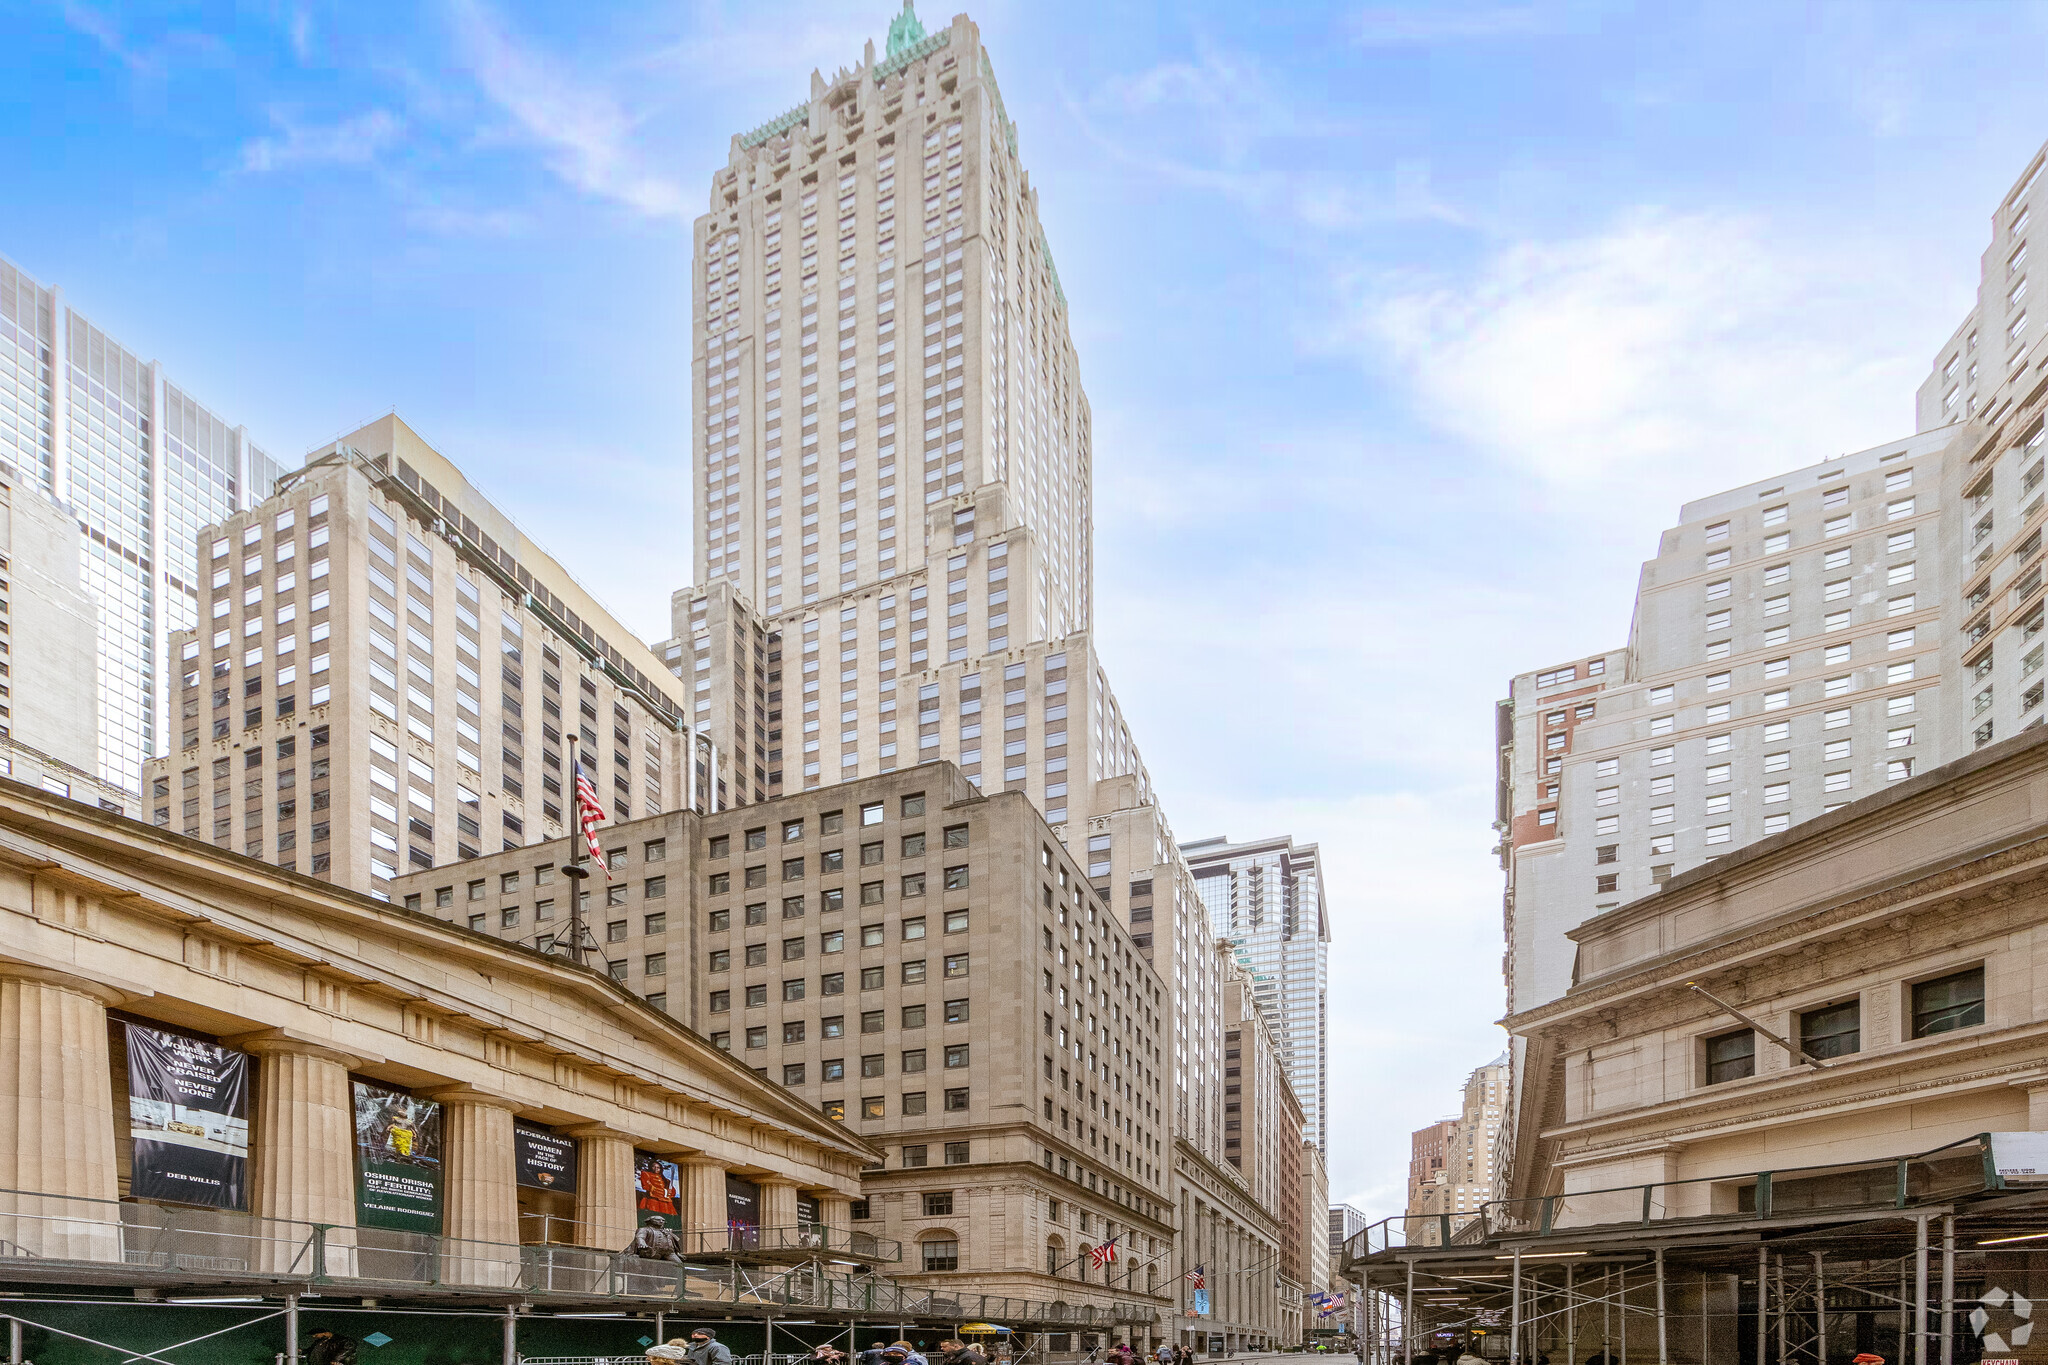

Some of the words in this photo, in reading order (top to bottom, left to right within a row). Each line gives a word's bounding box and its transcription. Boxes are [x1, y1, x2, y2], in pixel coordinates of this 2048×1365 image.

[160, 1040, 221, 1060] WOMEN'S
[173, 1050, 212, 1064] WORK
[166, 1066, 222, 1083] PRAISED
[173, 1060, 215, 1076] NEVER
[174, 1079, 216, 1094] NEVER
[178, 1086, 214, 1100] DONE
[516, 1128, 551, 1142] FEDERAL
[552, 1138, 572, 1148] HALL
[528, 1142, 562, 1156] WOMEN
[527, 1158, 564, 1172] HISTORY
[166, 1172, 187, 1180] DEB
[189, 1175, 220, 1186] WILLIS
[364, 1172, 398, 1182] OSHUN
[402, 1178, 434, 1188] ORISHA
[376, 1189, 416, 1198] REVOLUTIONARY
[384, 1182, 431, 1194] FERTILITY:
[729, 1194, 751, 1202] AMERICAN
[363, 1202, 396, 1211] YELAINE
[397, 1207, 434, 1217] RODRIGUEZ
